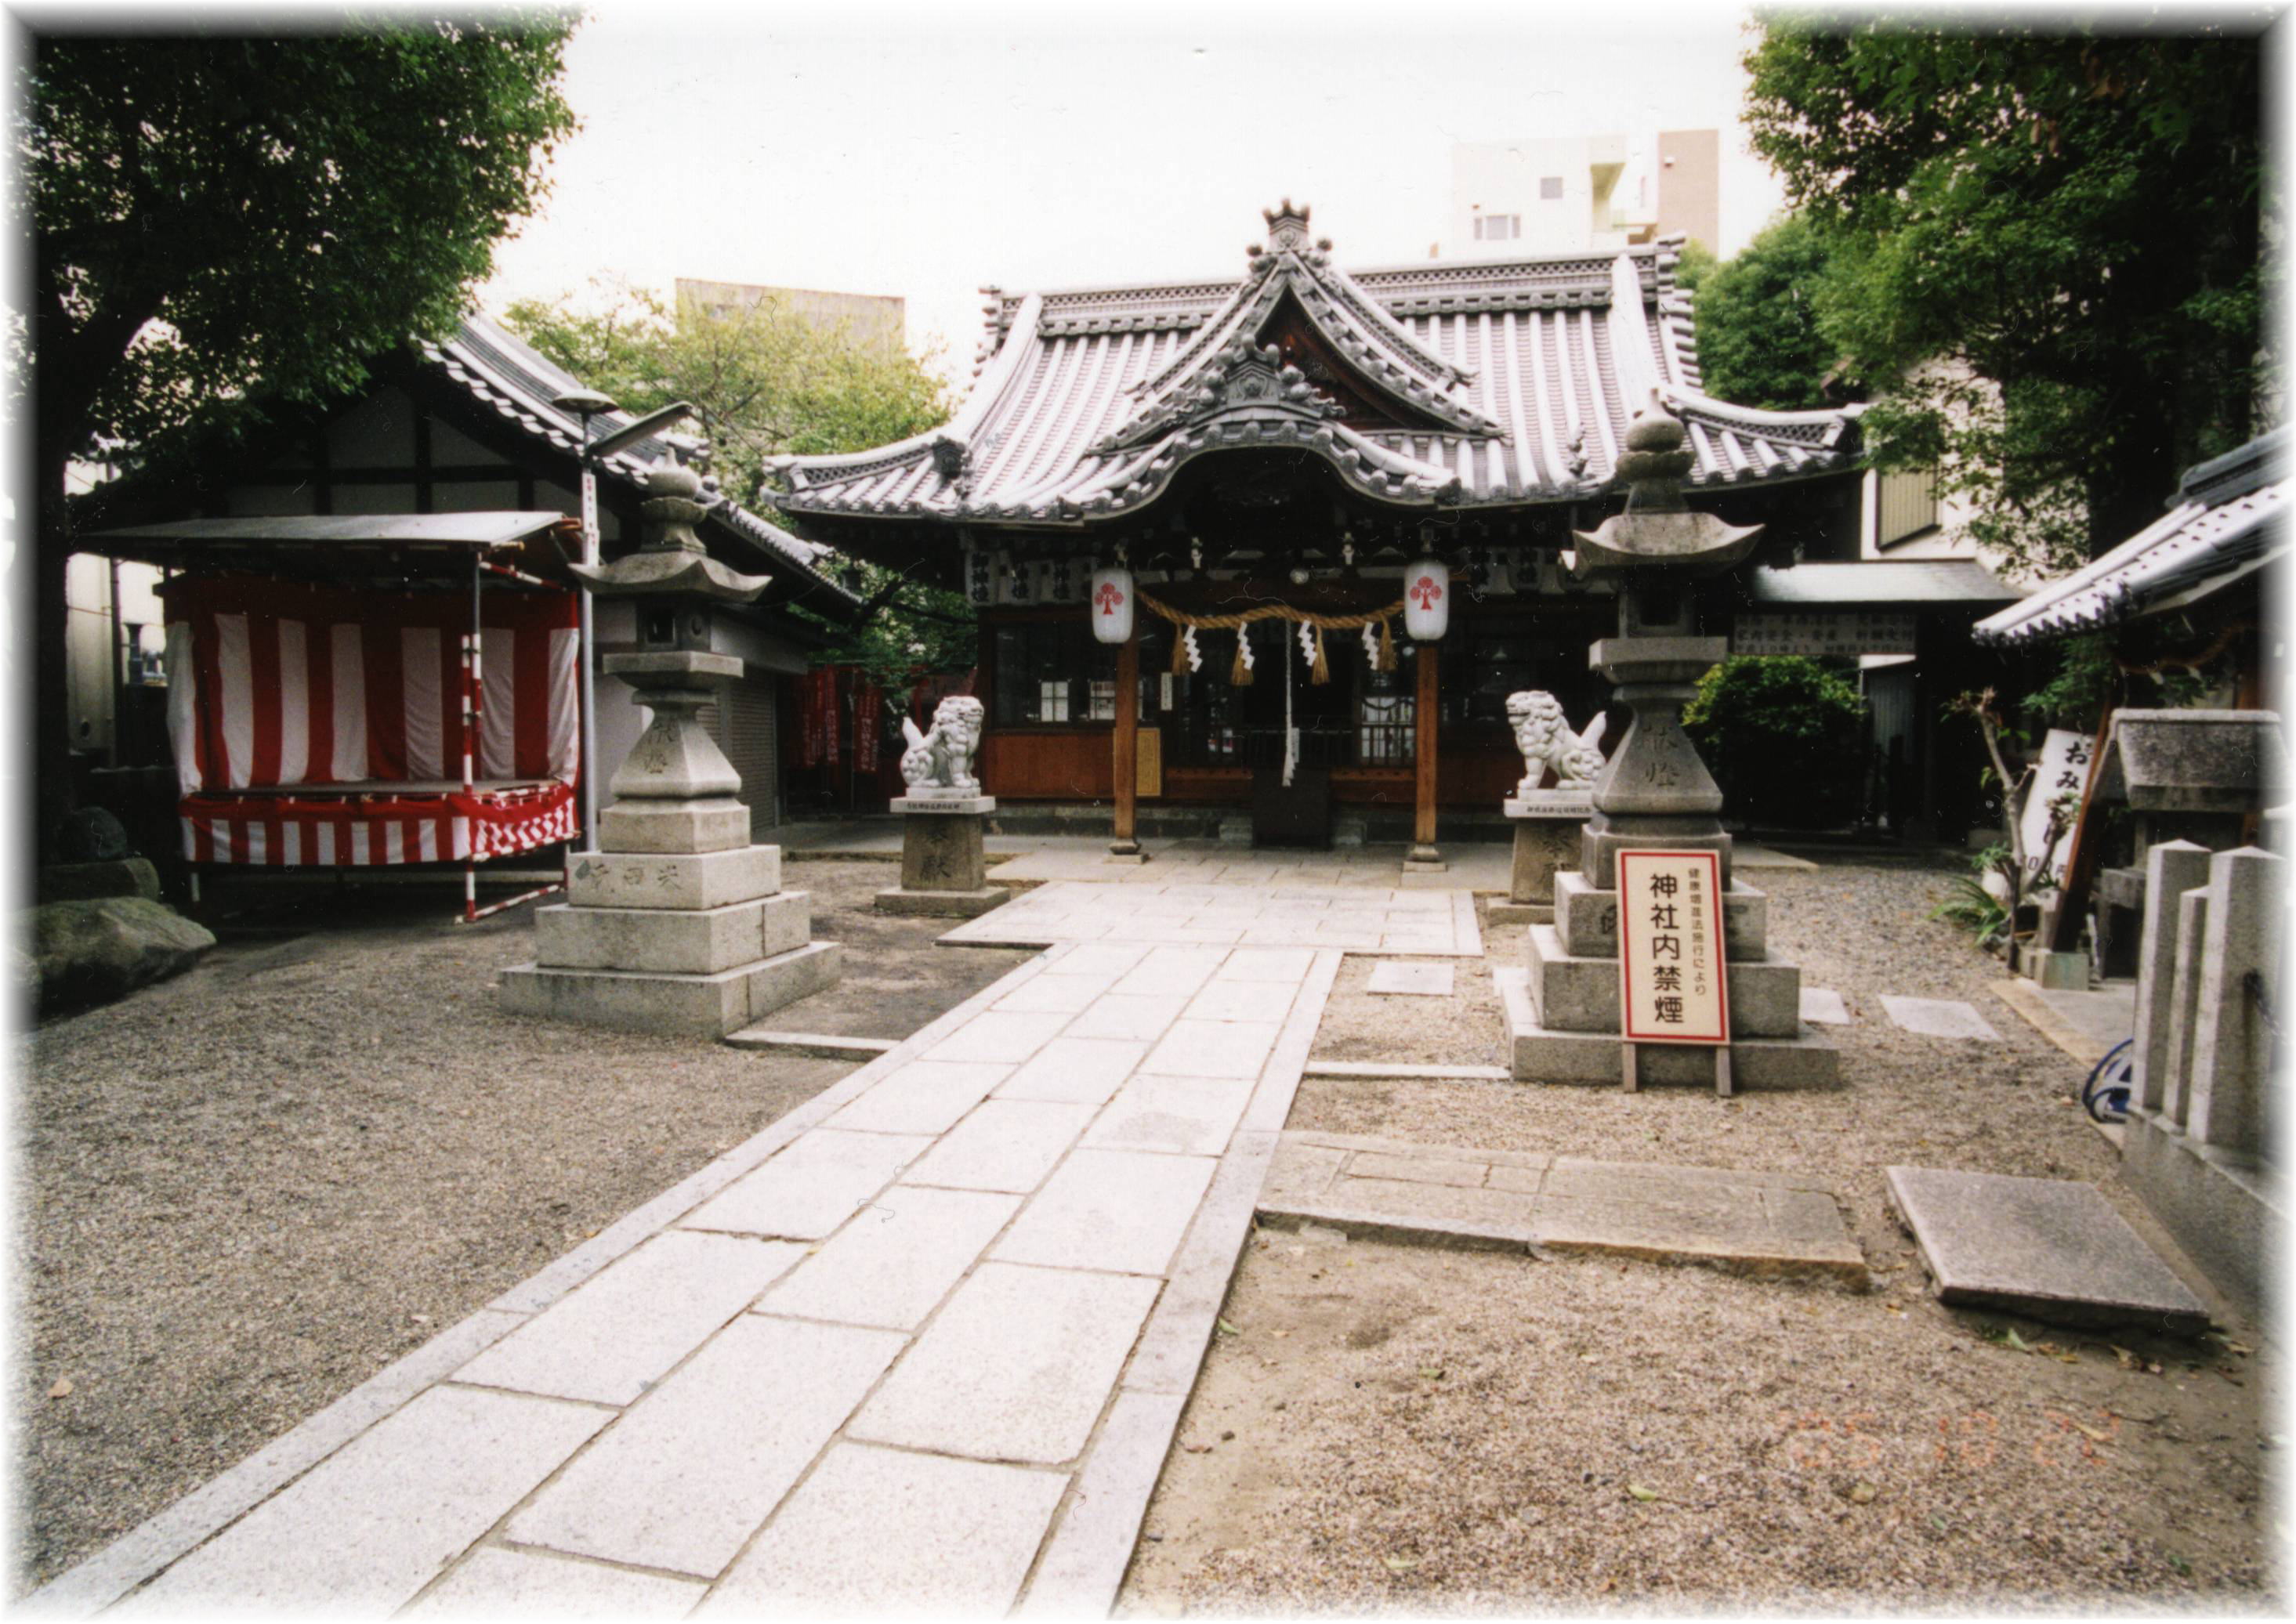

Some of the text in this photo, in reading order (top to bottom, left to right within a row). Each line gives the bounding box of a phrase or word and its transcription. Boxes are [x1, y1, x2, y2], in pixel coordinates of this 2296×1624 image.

[1650, 873, 1685, 1024] 神社内禁煙
[1688, 867, 1707, 996] 健康増進法施行により
